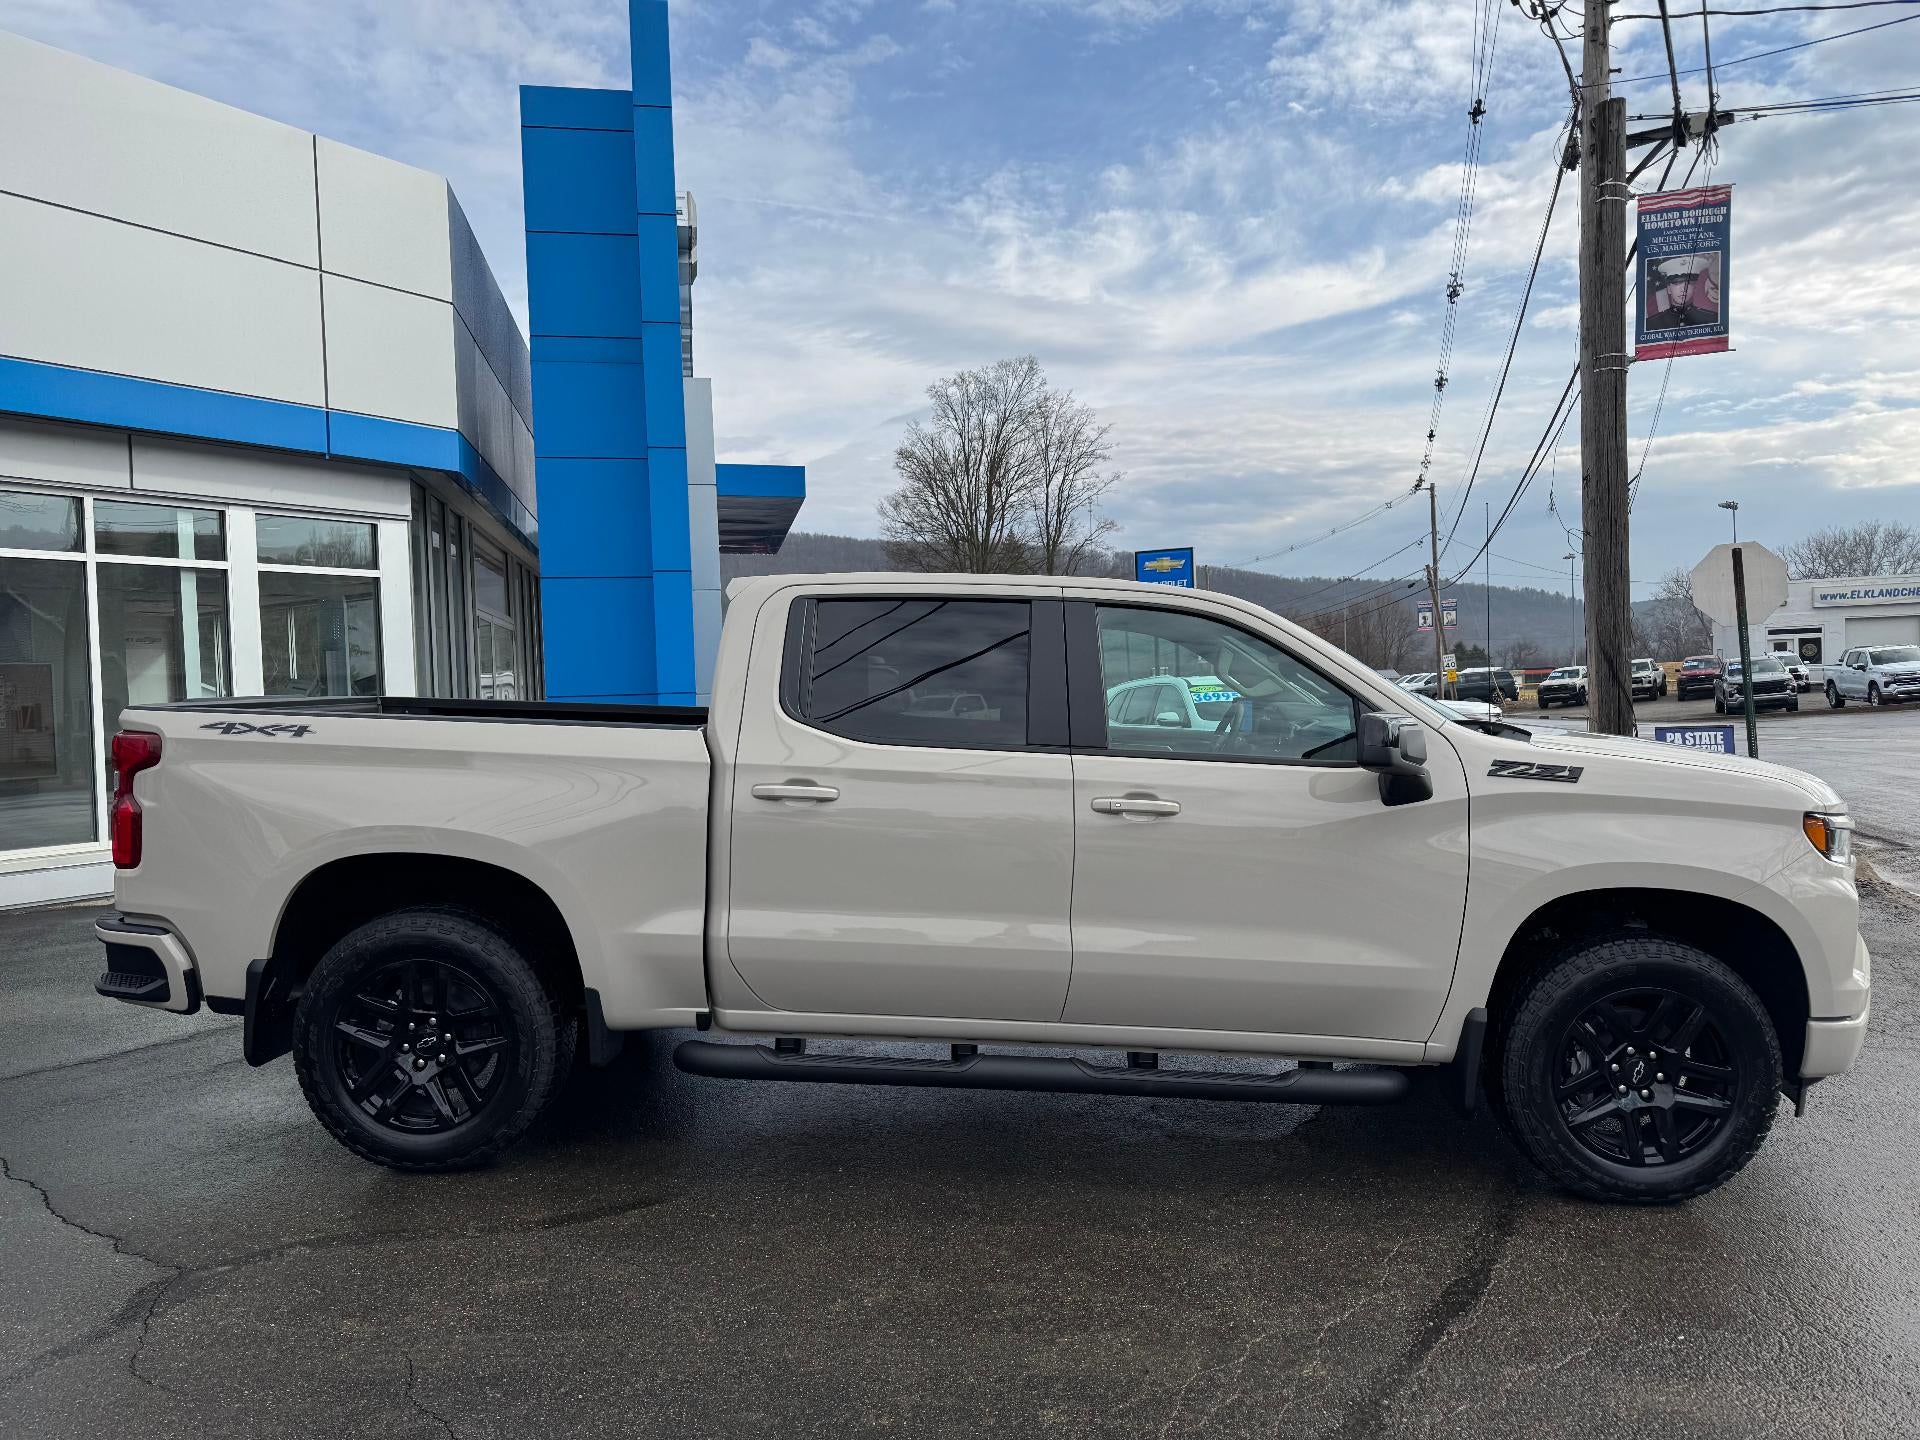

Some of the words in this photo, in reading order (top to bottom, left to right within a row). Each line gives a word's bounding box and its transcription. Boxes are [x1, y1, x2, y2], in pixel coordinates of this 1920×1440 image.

[1641, 212, 1680, 223] ELKLAND
[1682, 207, 1727, 218] BOROUGH
[1644, 218, 1695, 230] HOMETOWN
[1698, 215, 1723, 225] HERO
[1652, 235, 1687, 244] MICHAEL
[1662, 242, 1693, 252] MARINE
[1695, 240, 1720, 249] CORPS
[1640, 333, 1663, 341] GLOBAL
[1666, 733, 1682, 744] PA
[1685, 732, 1724, 745] STATE
